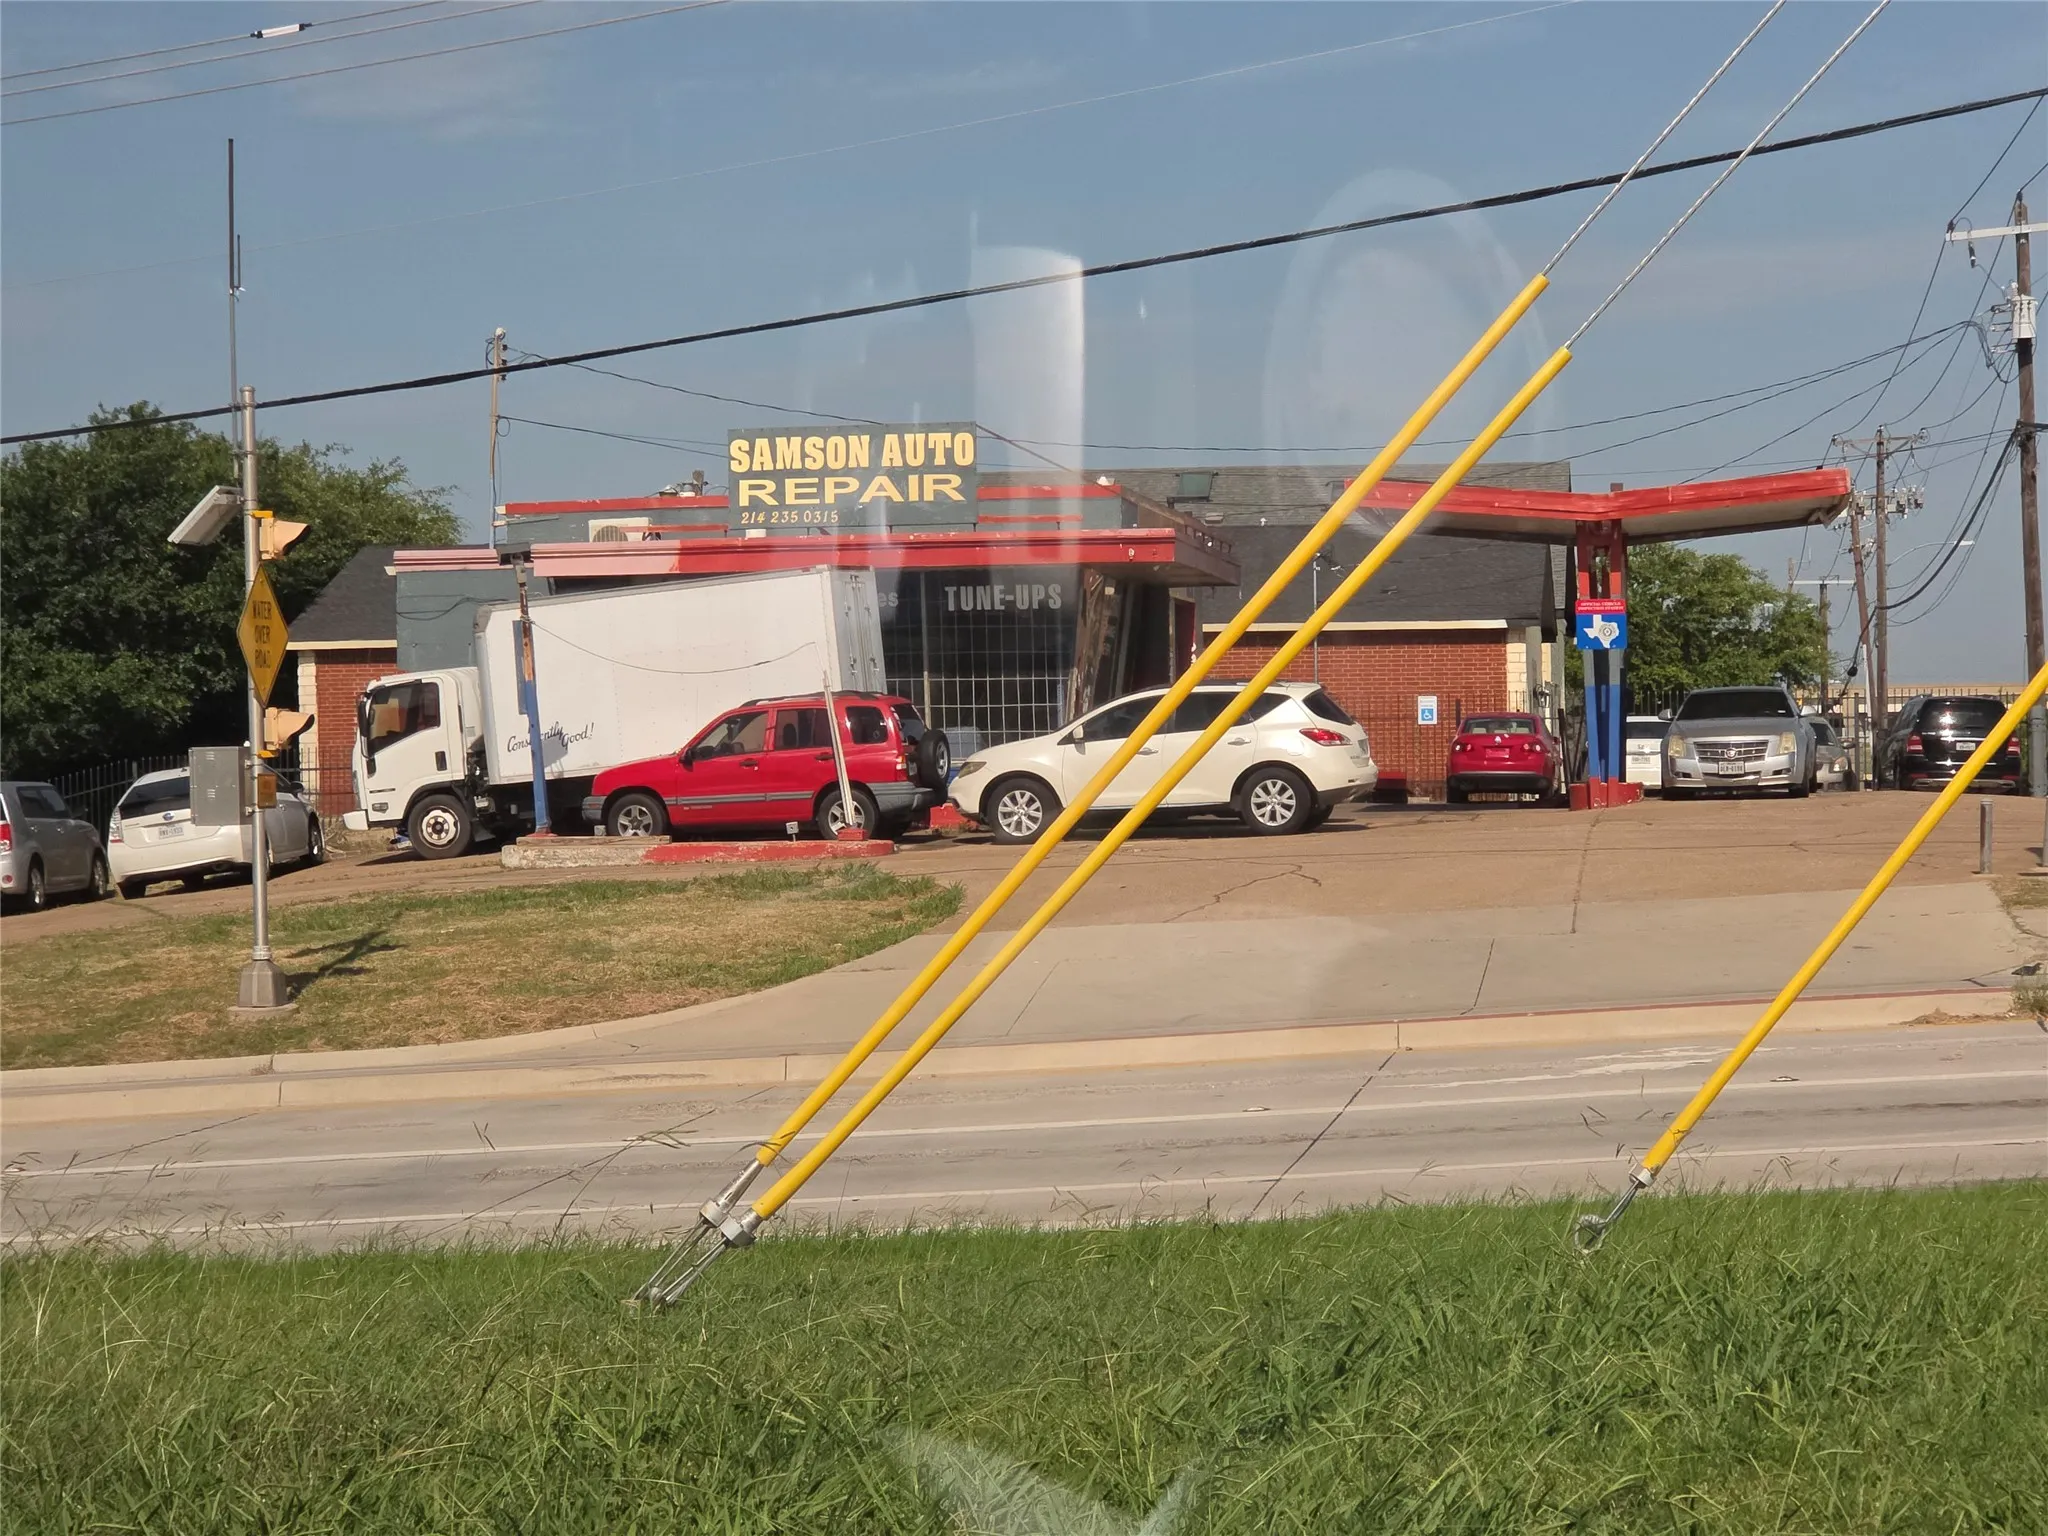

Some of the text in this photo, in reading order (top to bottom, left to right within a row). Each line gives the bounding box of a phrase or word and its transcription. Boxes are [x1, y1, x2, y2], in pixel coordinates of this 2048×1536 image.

[729, 432, 975, 473] SAMSON AUTO
[738, 473, 967, 507] REPAIR
[740, 508, 839, 525] 214 235 0315
[252, 600, 272, 620] WATER
[944, 583, 1062, 612] TUNE-UPS
[254, 624, 271, 644] OVER
[561, 722, 594, 751] Good!
